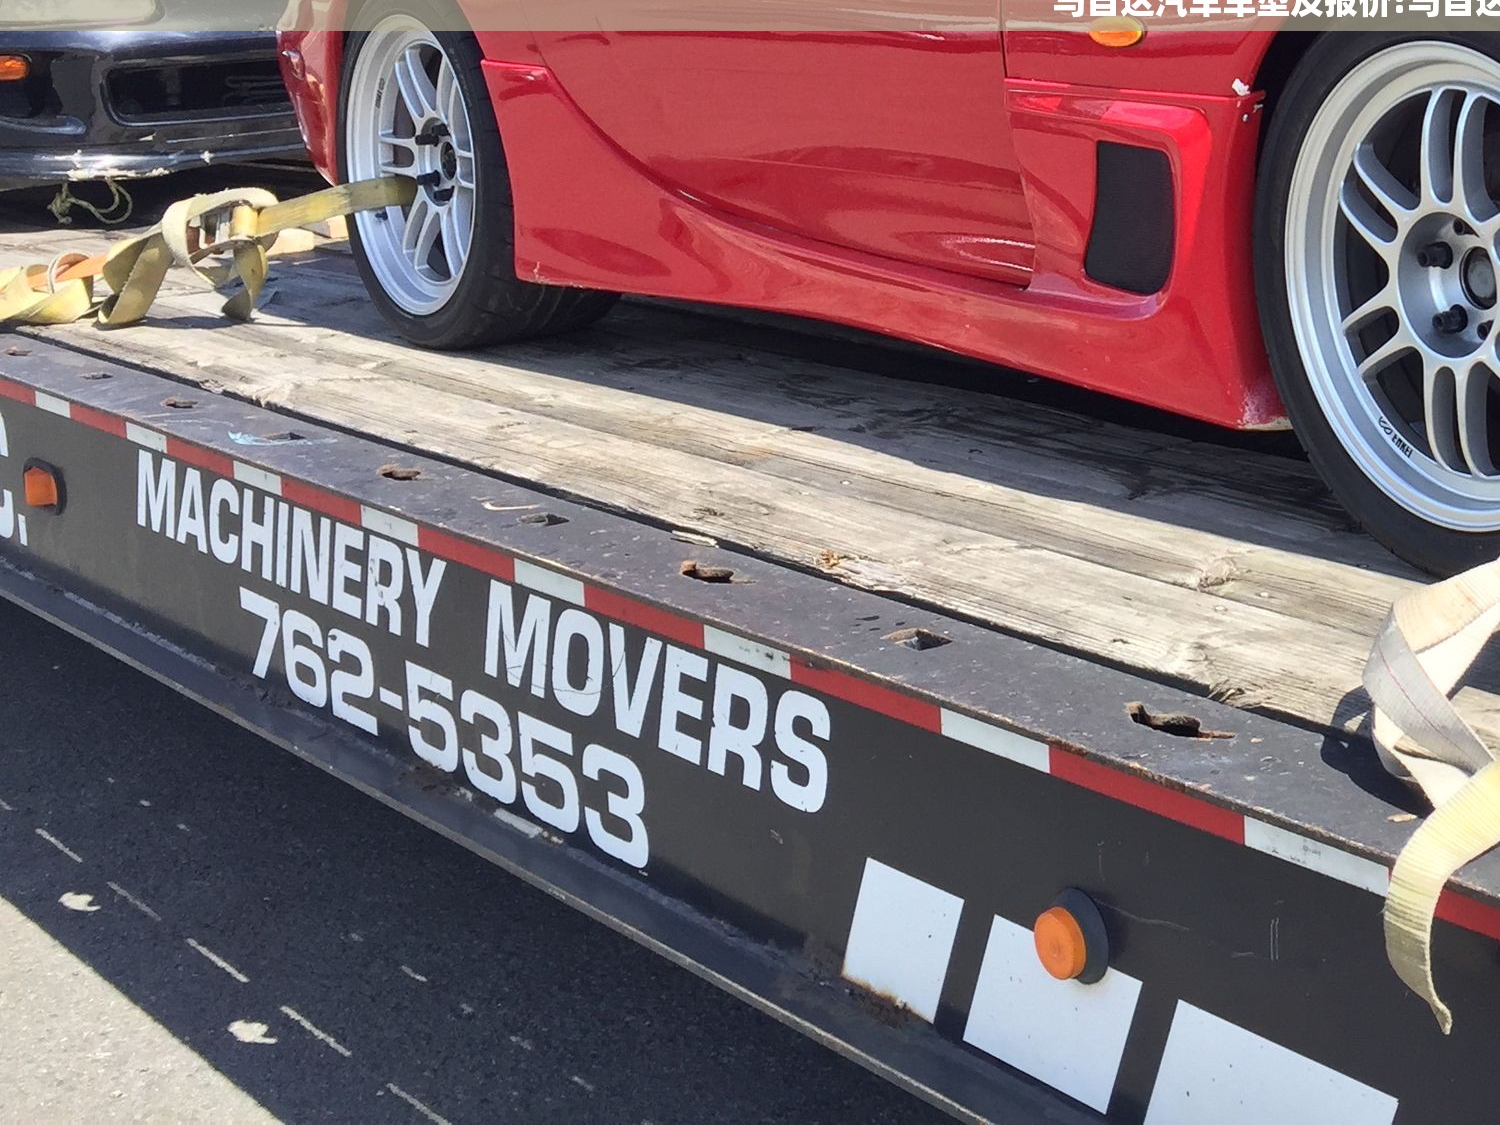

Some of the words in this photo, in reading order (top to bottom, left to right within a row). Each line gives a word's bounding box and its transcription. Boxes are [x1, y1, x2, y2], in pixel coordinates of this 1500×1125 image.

[136, 448, 447, 648] MACHINERY
[484, 579, 832, 813] MOVERS
[239, 586, 649, 870] 762-5353
